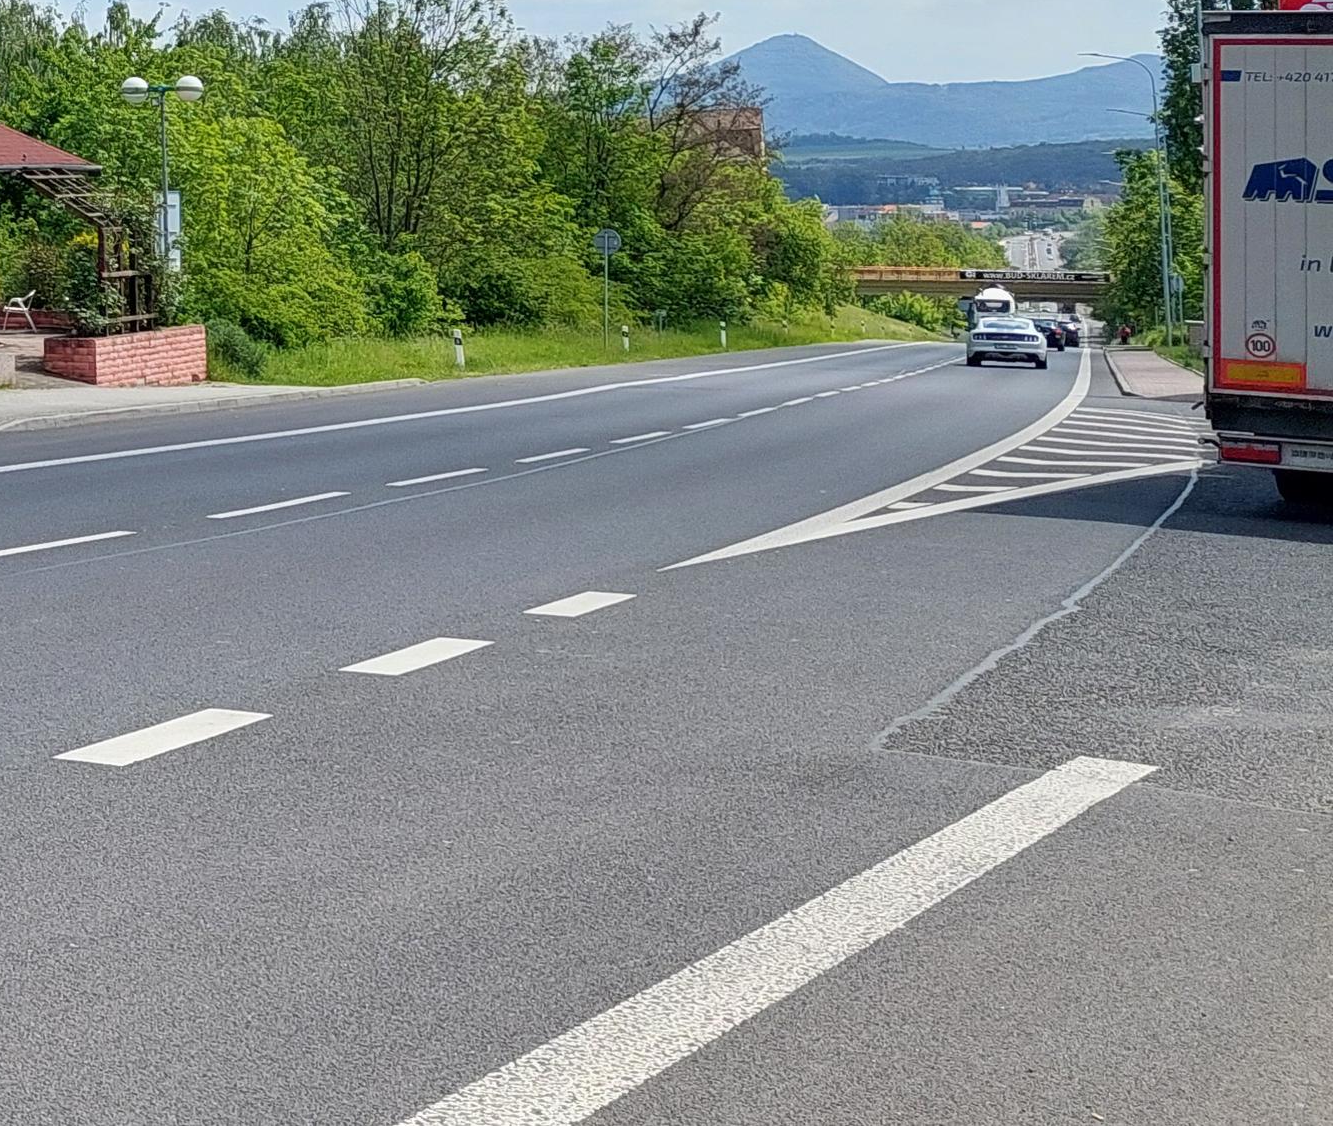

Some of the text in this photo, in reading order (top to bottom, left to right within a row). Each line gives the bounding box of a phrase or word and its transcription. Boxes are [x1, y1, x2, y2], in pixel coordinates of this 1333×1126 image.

[1244, 71, 1273, 82] TEL:
[1276, 72, 1312, 82] +420
[1300, 255, 1321, 272] in
[1250, 339, 1271, 352] 100
